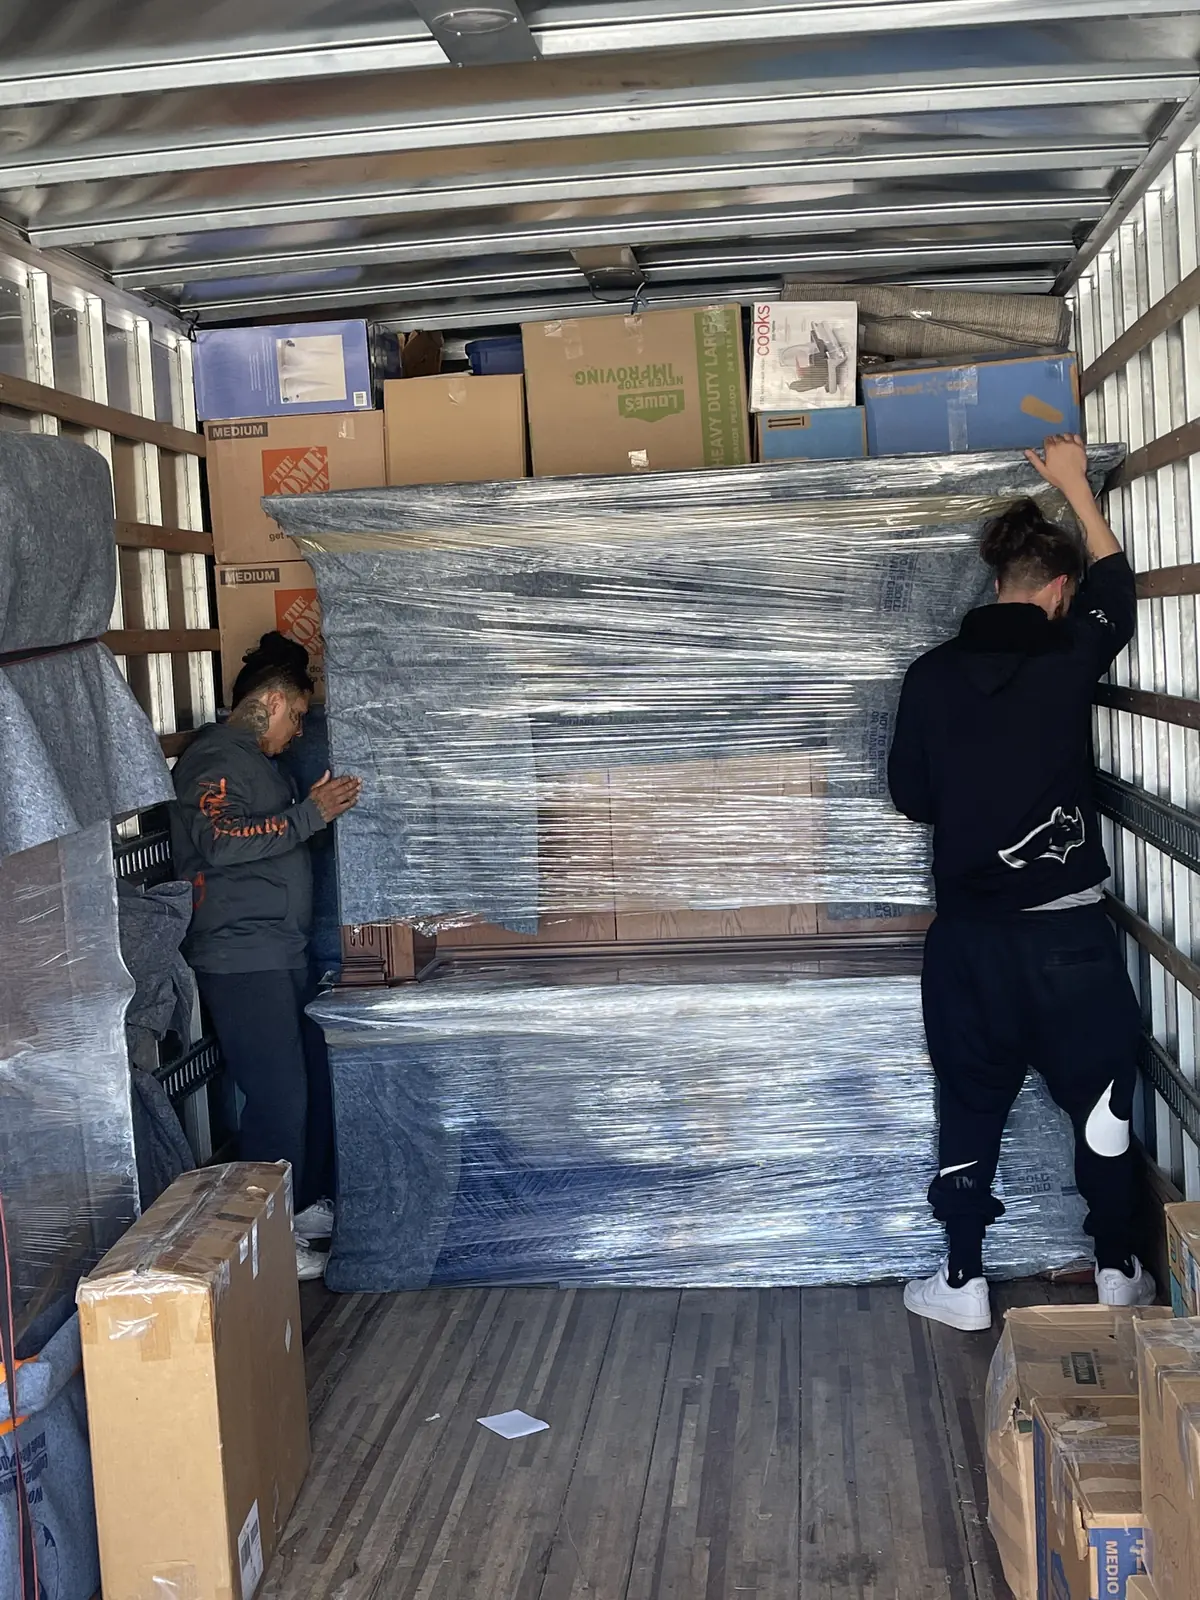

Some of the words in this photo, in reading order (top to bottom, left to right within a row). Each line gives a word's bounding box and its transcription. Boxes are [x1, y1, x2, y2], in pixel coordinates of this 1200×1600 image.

[702, 315, 718, 367] LARGE
[753, 304, 771, 356] cooks
[574, 363, 673, 386] IMPROVING
[617, 379, 645, 390] STOP
[647, 375, 684, 387] NEVER
[705, 371, 721, 412] DUTY
[212, 425, 264, 438] MEDIUM
[707, 416, 724, 466] HEAVY
[269, 456, 297, 484] THE
[224, 569, 276, 582] MEDIUM
[283, 596, 310, 625] THE
[879, 711, 889, 731] NOT
[878, 735, 887, 746] TO
[878, 767, 886, 794] SOLD
[1105, 1541, 1120, 1594] MEDIO
